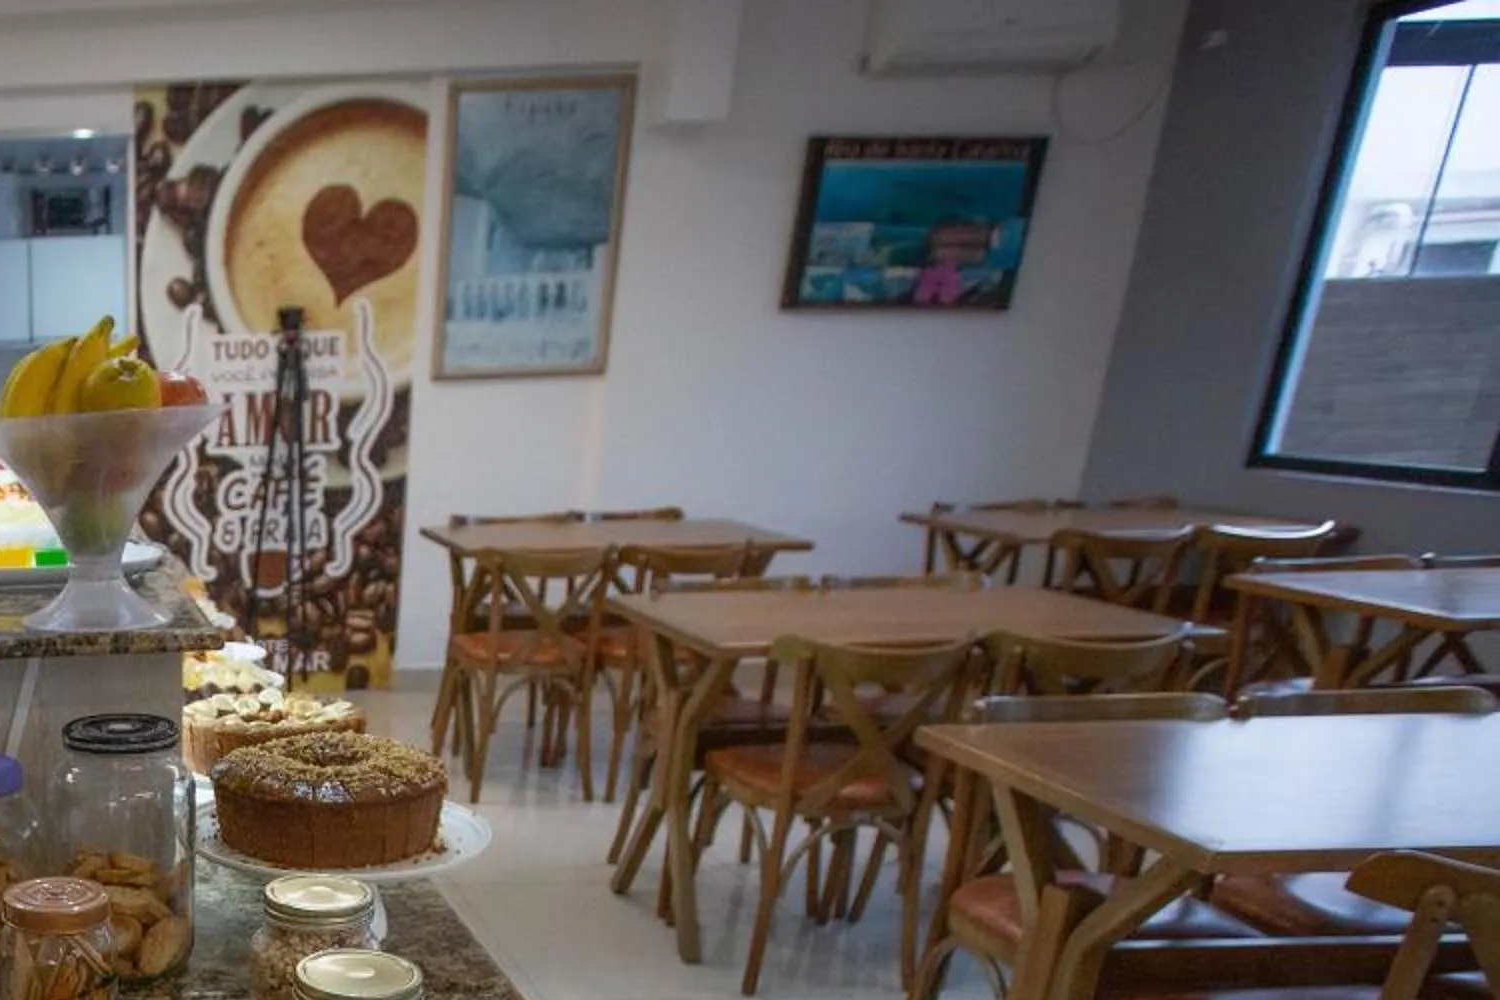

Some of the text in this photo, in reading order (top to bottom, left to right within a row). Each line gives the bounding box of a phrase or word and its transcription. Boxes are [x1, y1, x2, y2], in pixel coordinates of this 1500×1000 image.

[213, 337, 270, 361] TUDO
[216, 389, 333, 447] AMR
[251, 517, 323, 545] PRA
